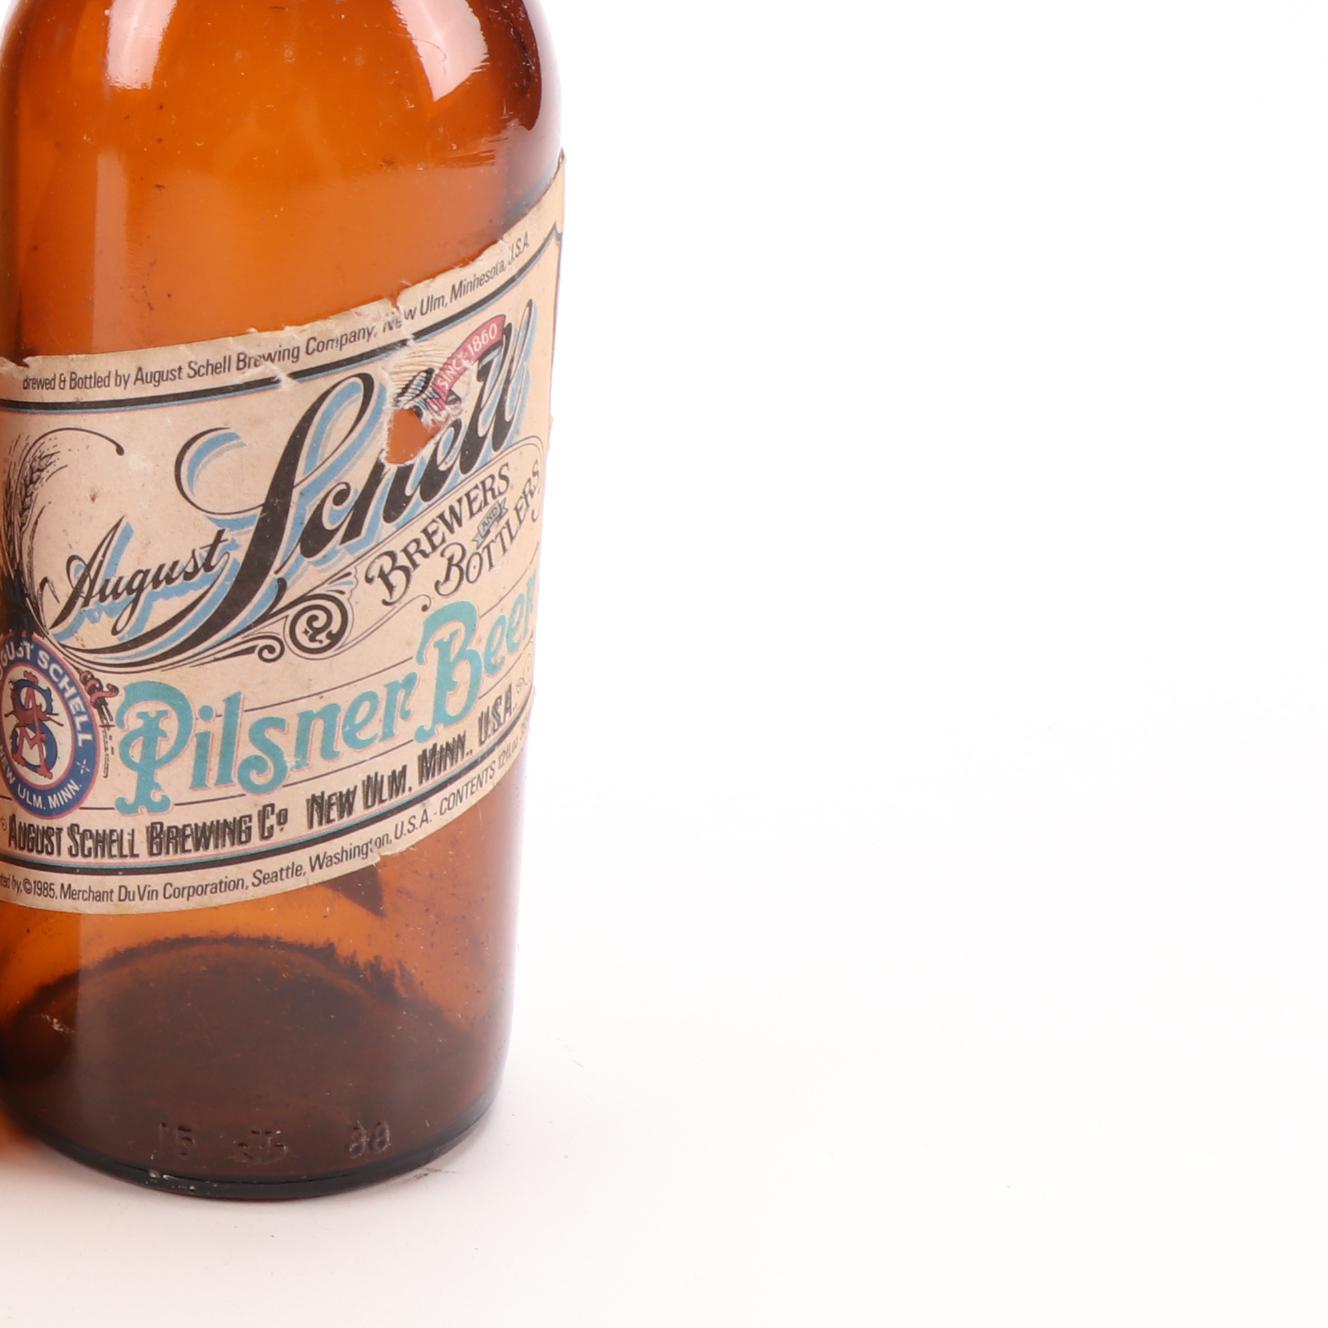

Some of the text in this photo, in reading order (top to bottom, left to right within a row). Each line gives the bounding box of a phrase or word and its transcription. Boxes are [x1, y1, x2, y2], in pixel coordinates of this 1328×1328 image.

[59, 374, 66, 390] &
[69, 371, 112, 390] Bottled
[114, 369, 131, 390] by
[133, 365, 184, 388] August
[187, 354, 232, 380] Schell
[235, 345, 301, 371] Brewing
[420, 293, 448, 317] Ulm,
[437, 322, 498, 388] SINCE 1860
[365, 462, 511, 606] BREWERS
[435, 460, 541, 596] BOTTLERS
[481, 506, 500, 533] AND
[47, 514, 231, 635] August
[37, 649, 94, 747] SCHELL
[115, 669, 417, 815] Pilsner
[415, 575, 537, 743] Beer
[8, 813, 63, 857] AUGUST
[68, 823, 139, 859] SCHELL
[146, 813, 252, 857] BREWING
[307, 785, 358, 830] NEW
[60, 881, 114, 903] Merchant
[163, 876, 249, 901] Corporation,
[251, 860, 306, 888] Seattle,
[309, 833, 392, 873] Washington,
[394, 807, 432, 841] U.S.A.
[439, 760, 498, 816] CONTENTS
